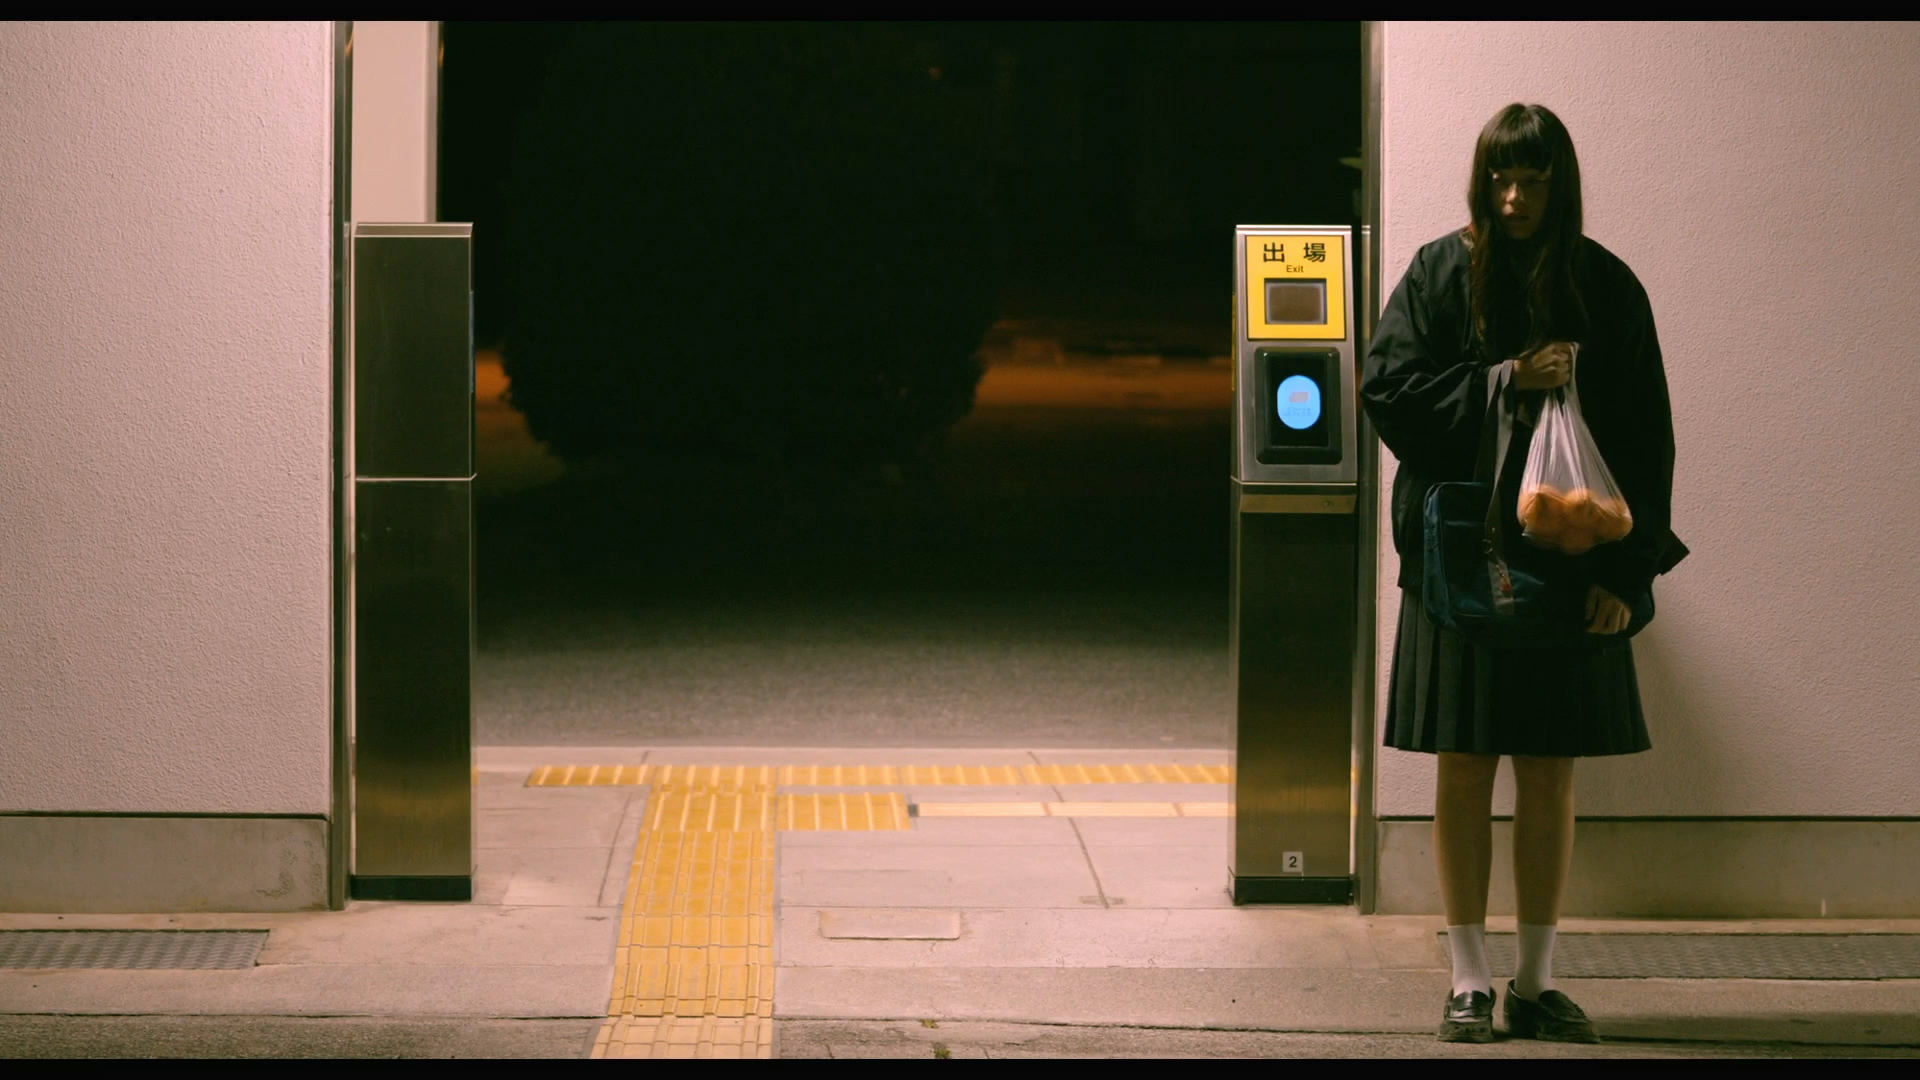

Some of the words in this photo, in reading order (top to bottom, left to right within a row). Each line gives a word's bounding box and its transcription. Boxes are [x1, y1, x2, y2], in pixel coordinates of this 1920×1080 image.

[1263, 242, 1326, 263] 出場
[1286, 264, 1304, 273] Exit
[1288, 855, 1298, 868] 2
